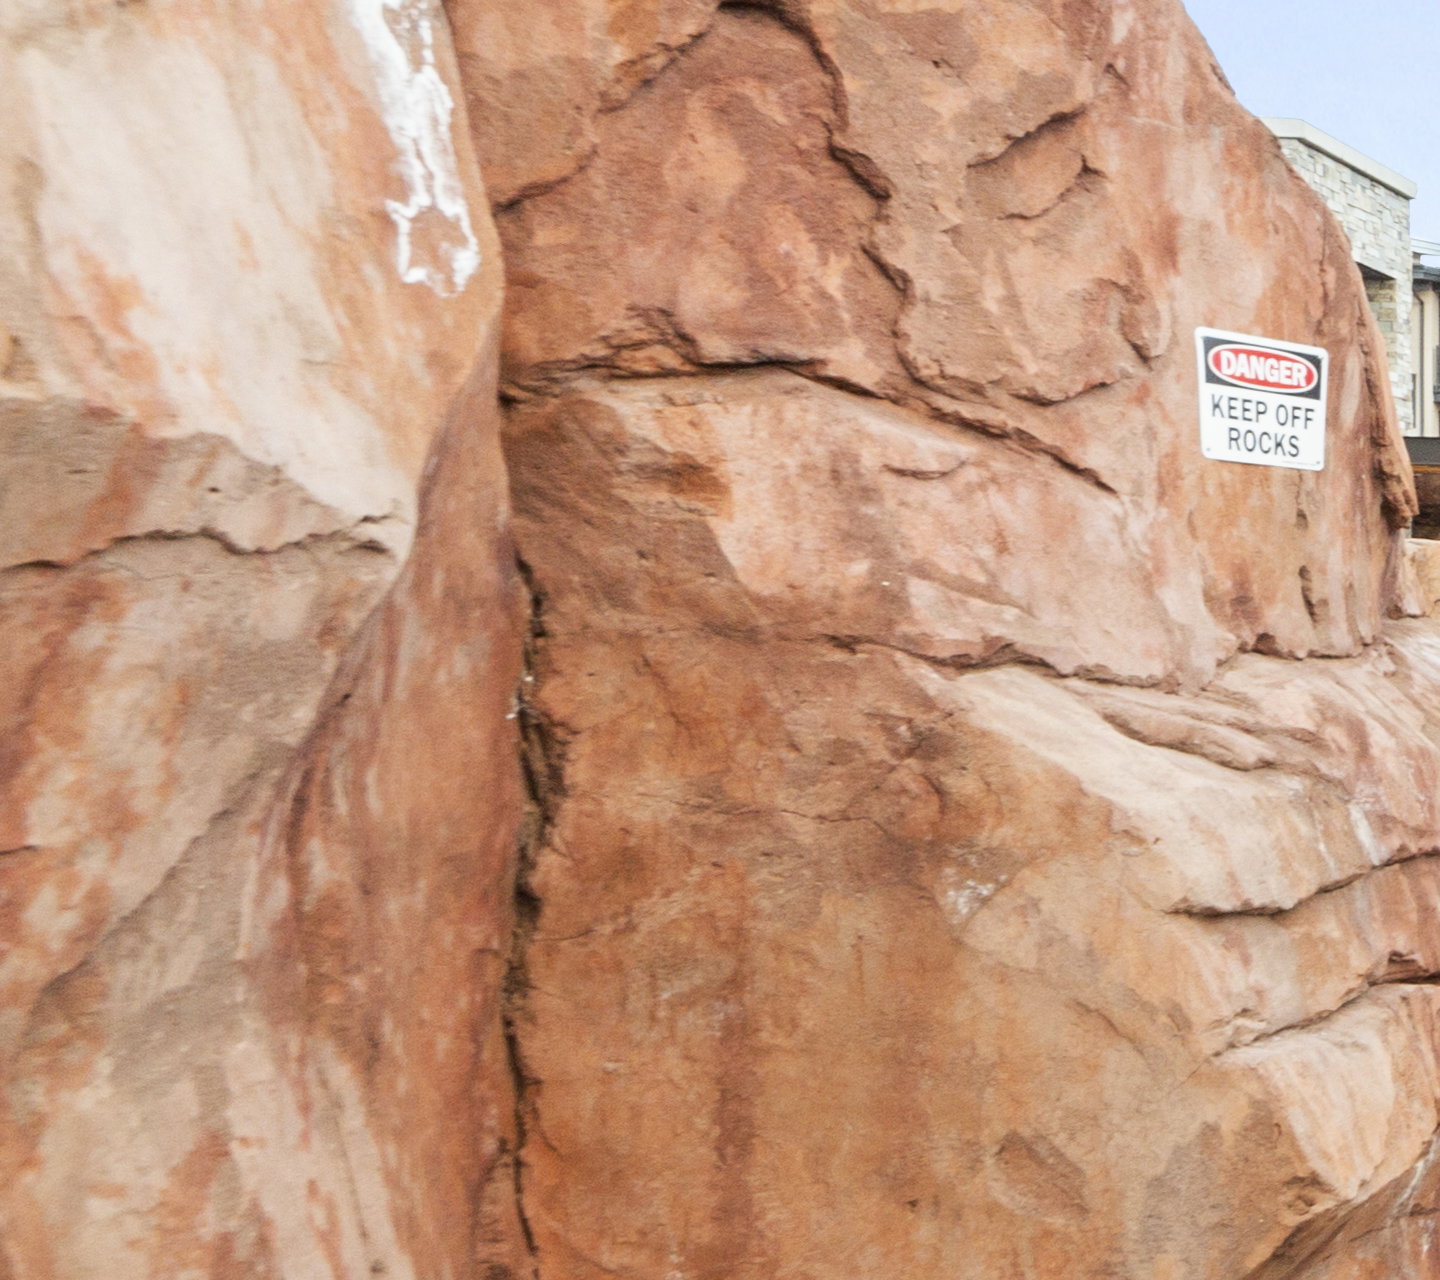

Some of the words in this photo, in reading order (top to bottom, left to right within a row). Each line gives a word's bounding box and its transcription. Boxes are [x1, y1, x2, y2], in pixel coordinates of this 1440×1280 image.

[1220, 350, 1308, 387] DANGER
[1211, 393, 1268, 423] KEEP
[1275, 404, 1315, 430] OFF
[1228, 426, 1300, 458] ROCKS
